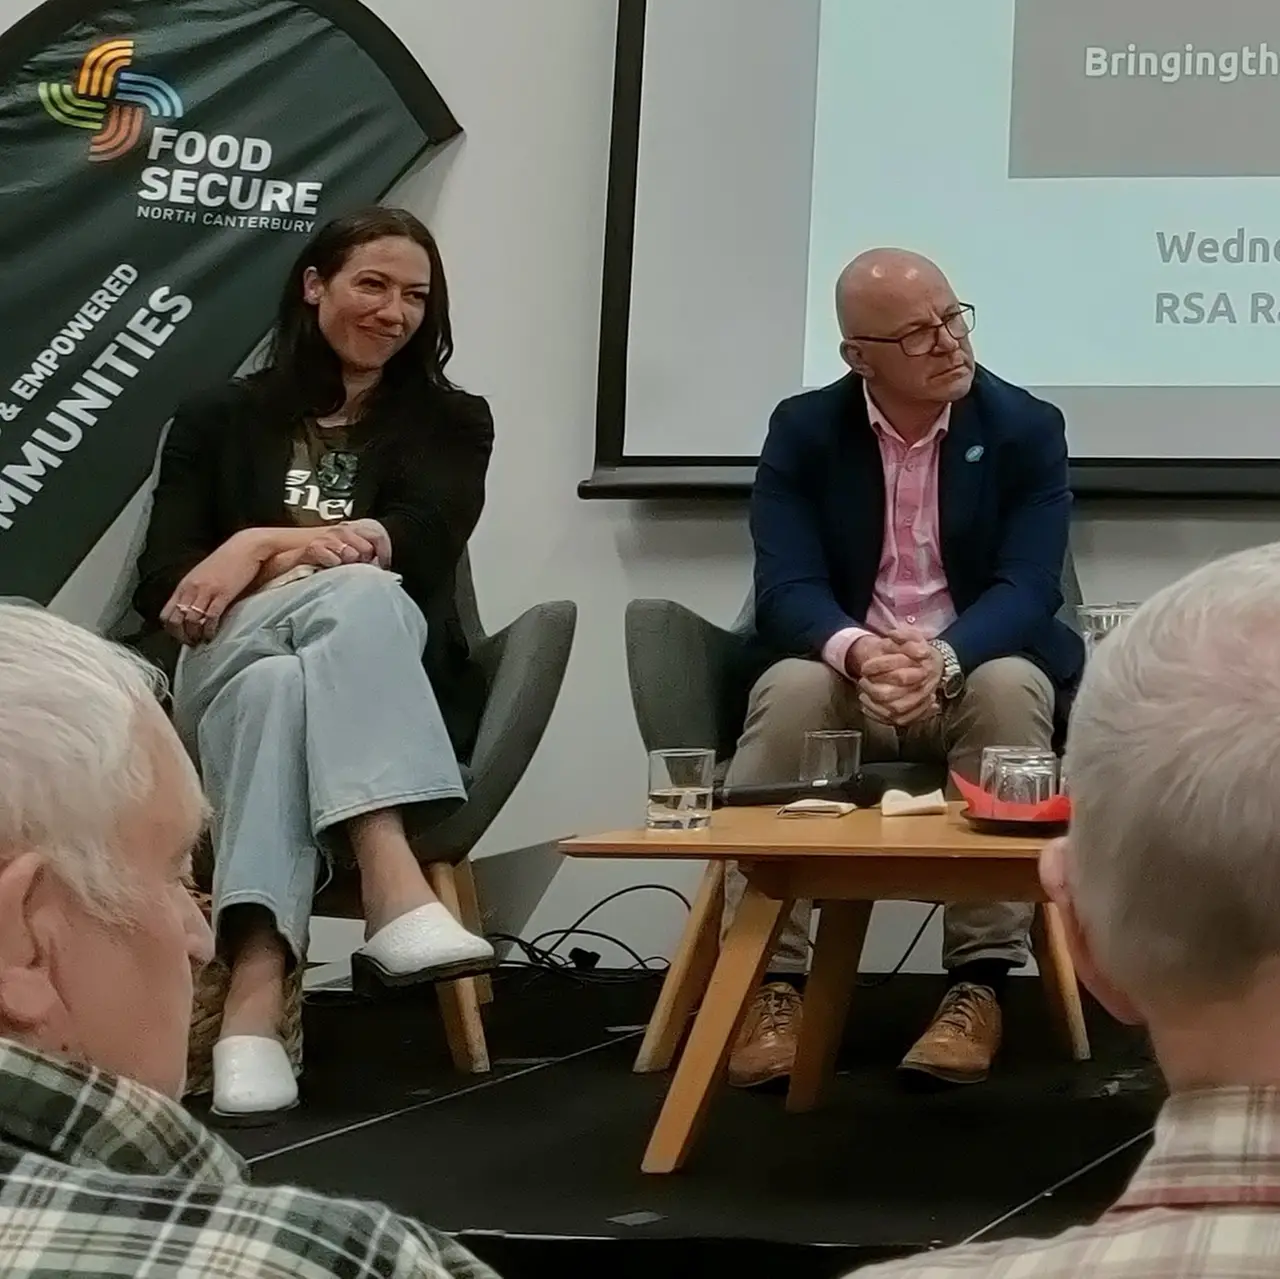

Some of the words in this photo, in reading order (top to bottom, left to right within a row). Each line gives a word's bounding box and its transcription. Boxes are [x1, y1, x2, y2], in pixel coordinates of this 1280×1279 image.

[147, 127, 272, 172] FOOD
[138, 166, 323, 215] SECURE
[137, 205, 197, 224] NORTH
[202, 213, 315, 233] CANTERBURY
[1155, 291, 1237, 325] RSA
[9, 263, 138, 401] EMPOWERED
[0, 402, 24, 421] &
